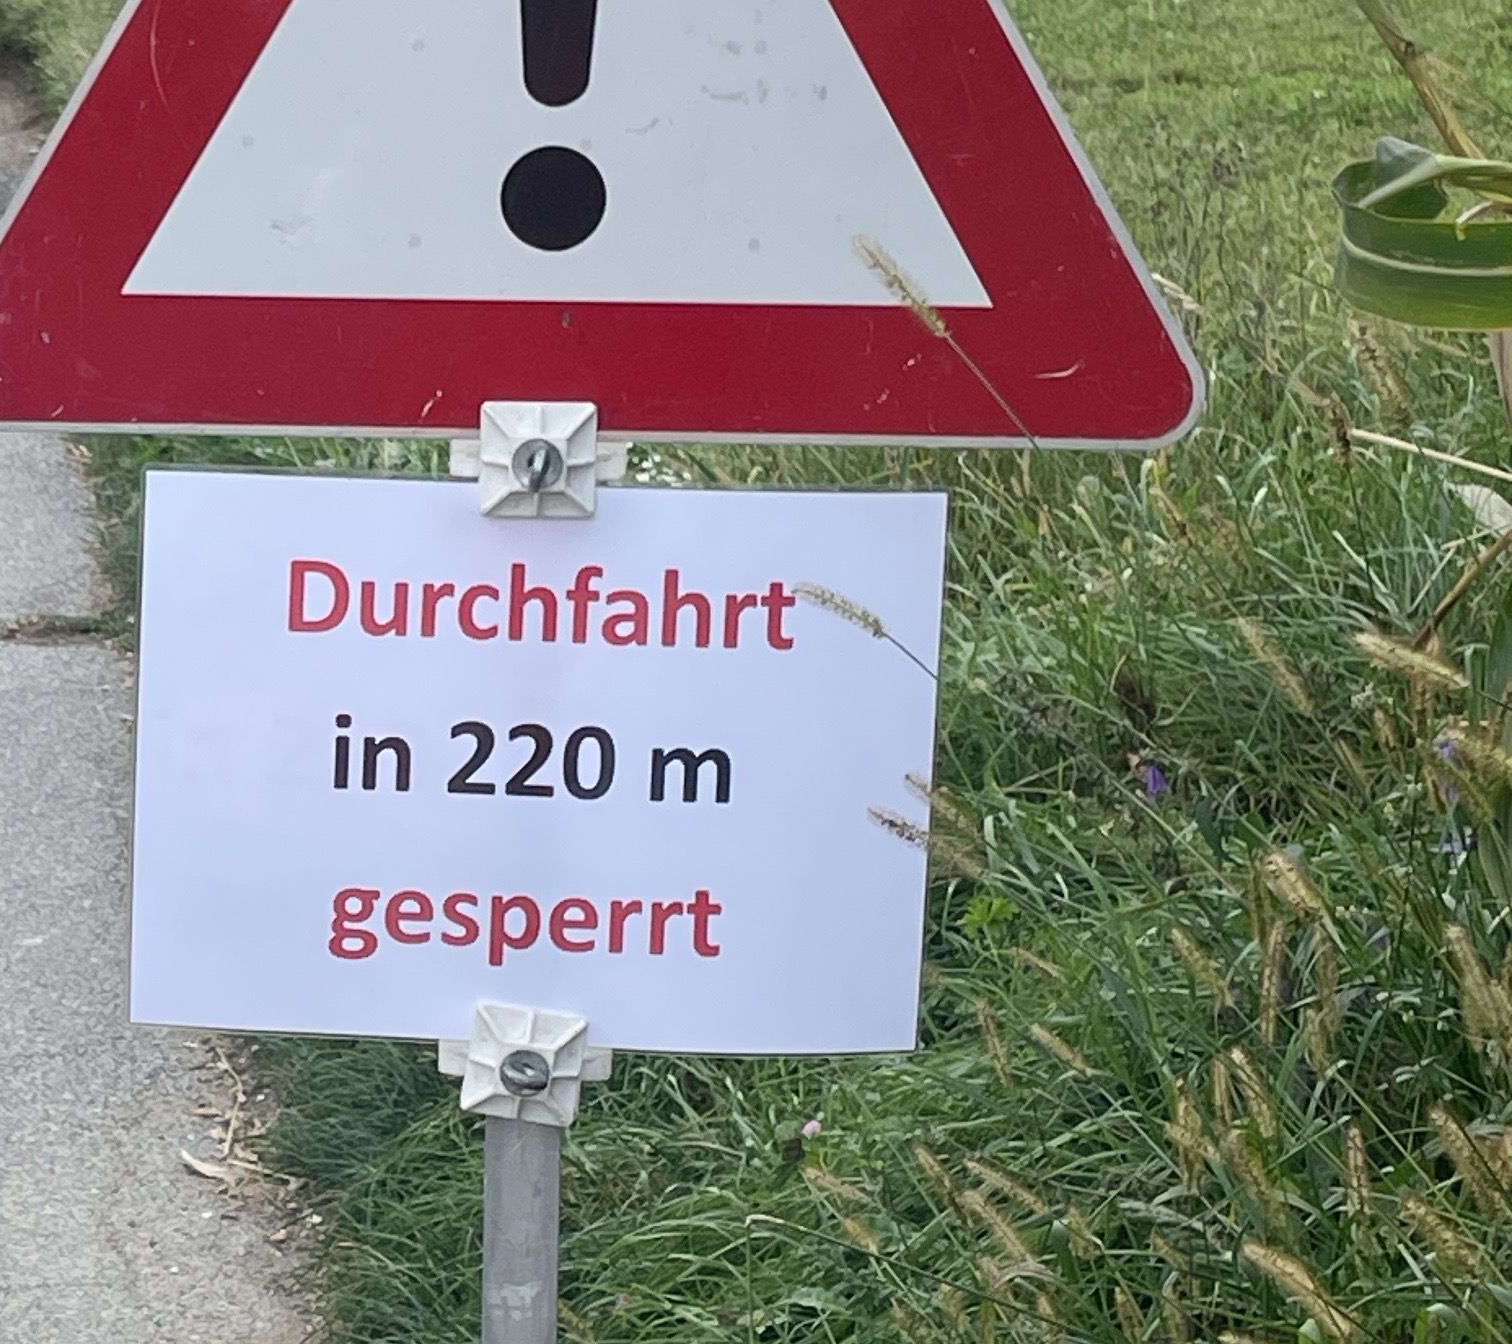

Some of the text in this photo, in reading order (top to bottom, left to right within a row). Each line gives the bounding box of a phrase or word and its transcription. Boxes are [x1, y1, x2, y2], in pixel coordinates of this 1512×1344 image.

[288, 557, 797, 651] Durchfahrt
[333, 713, 732, 805] in 220 m
[328, 887, 723, 966] gesperrt
